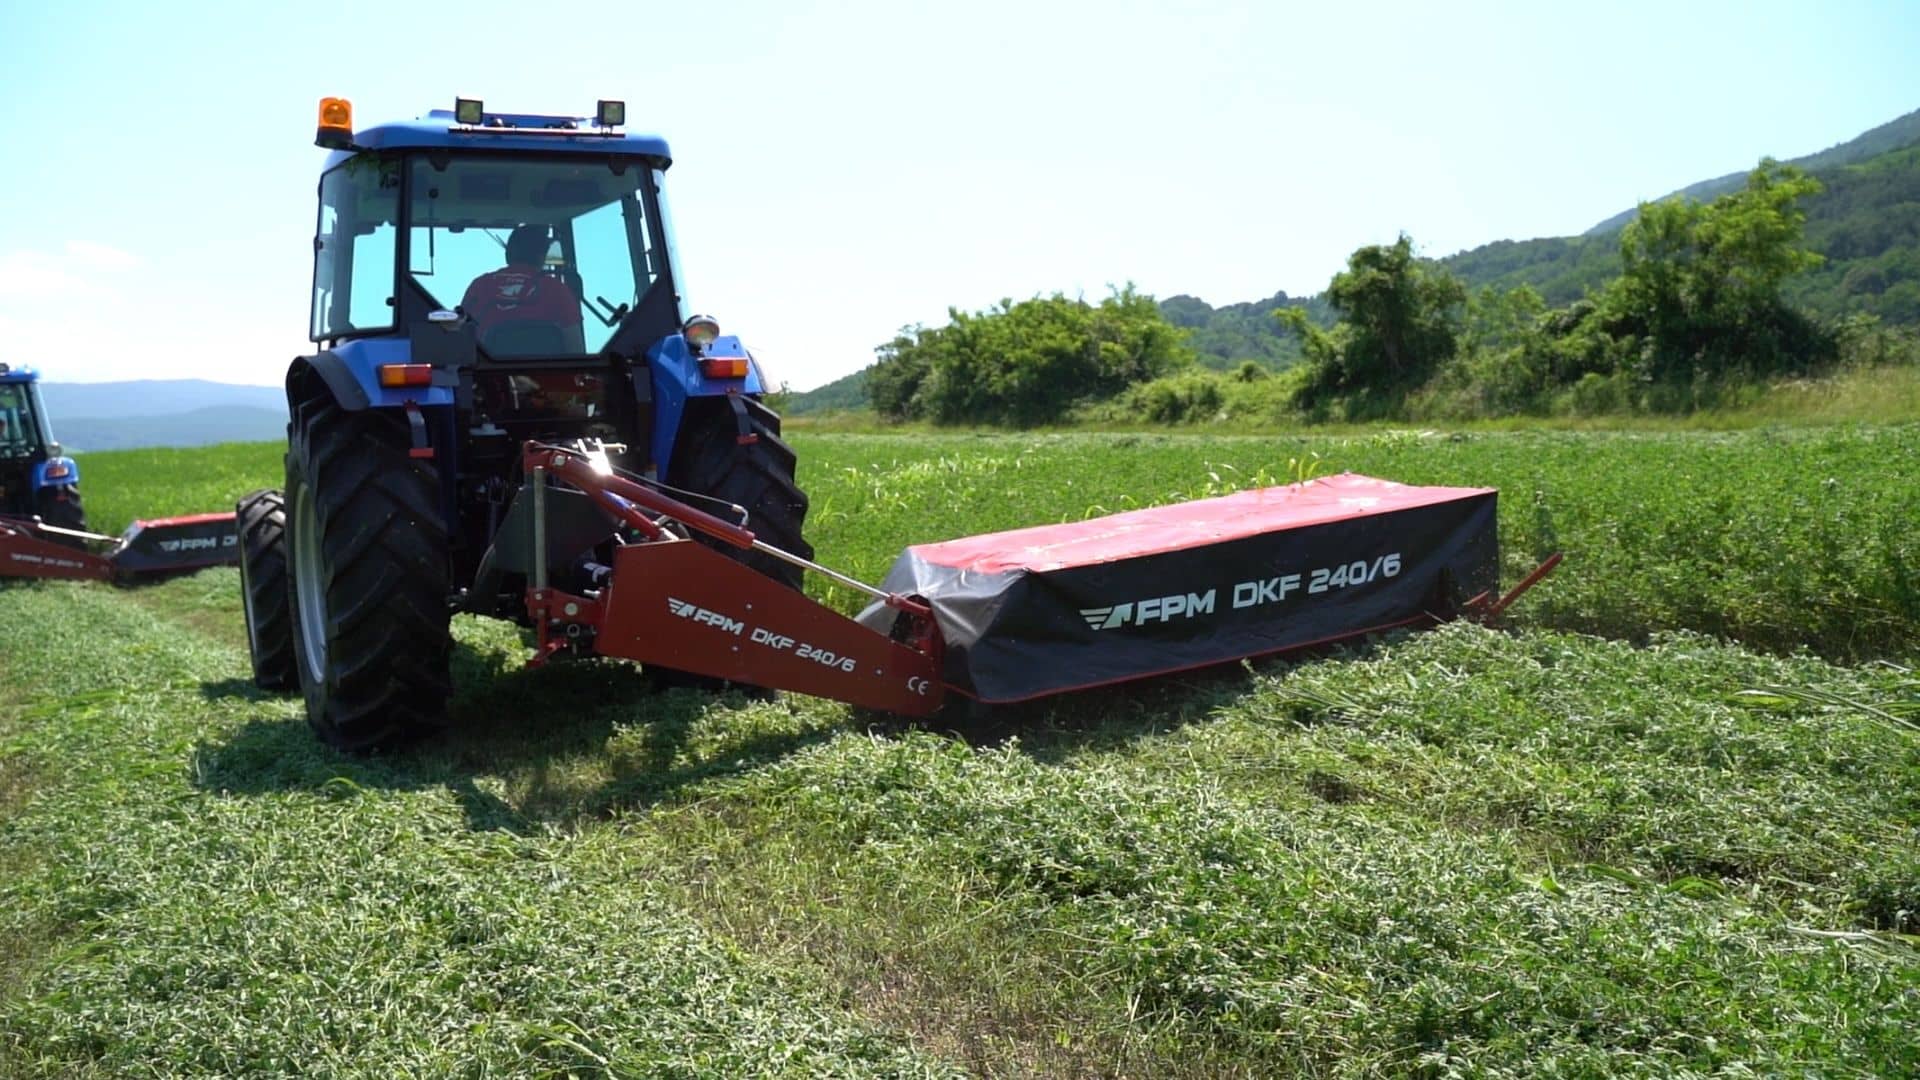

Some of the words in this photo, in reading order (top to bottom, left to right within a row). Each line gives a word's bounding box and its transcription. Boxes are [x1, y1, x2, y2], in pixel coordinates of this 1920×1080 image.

[221, 534, 239, 547] D
[1134, 588, 1217, 627] FPM
[1232, 573, 1302, 609] DKF
[1308, 552, 1401, 594] 240/6
[693, 608, 744, 636] FPM
[750, 628, 796, 650] DKF
[795, 642, 857, 673] 240/6
